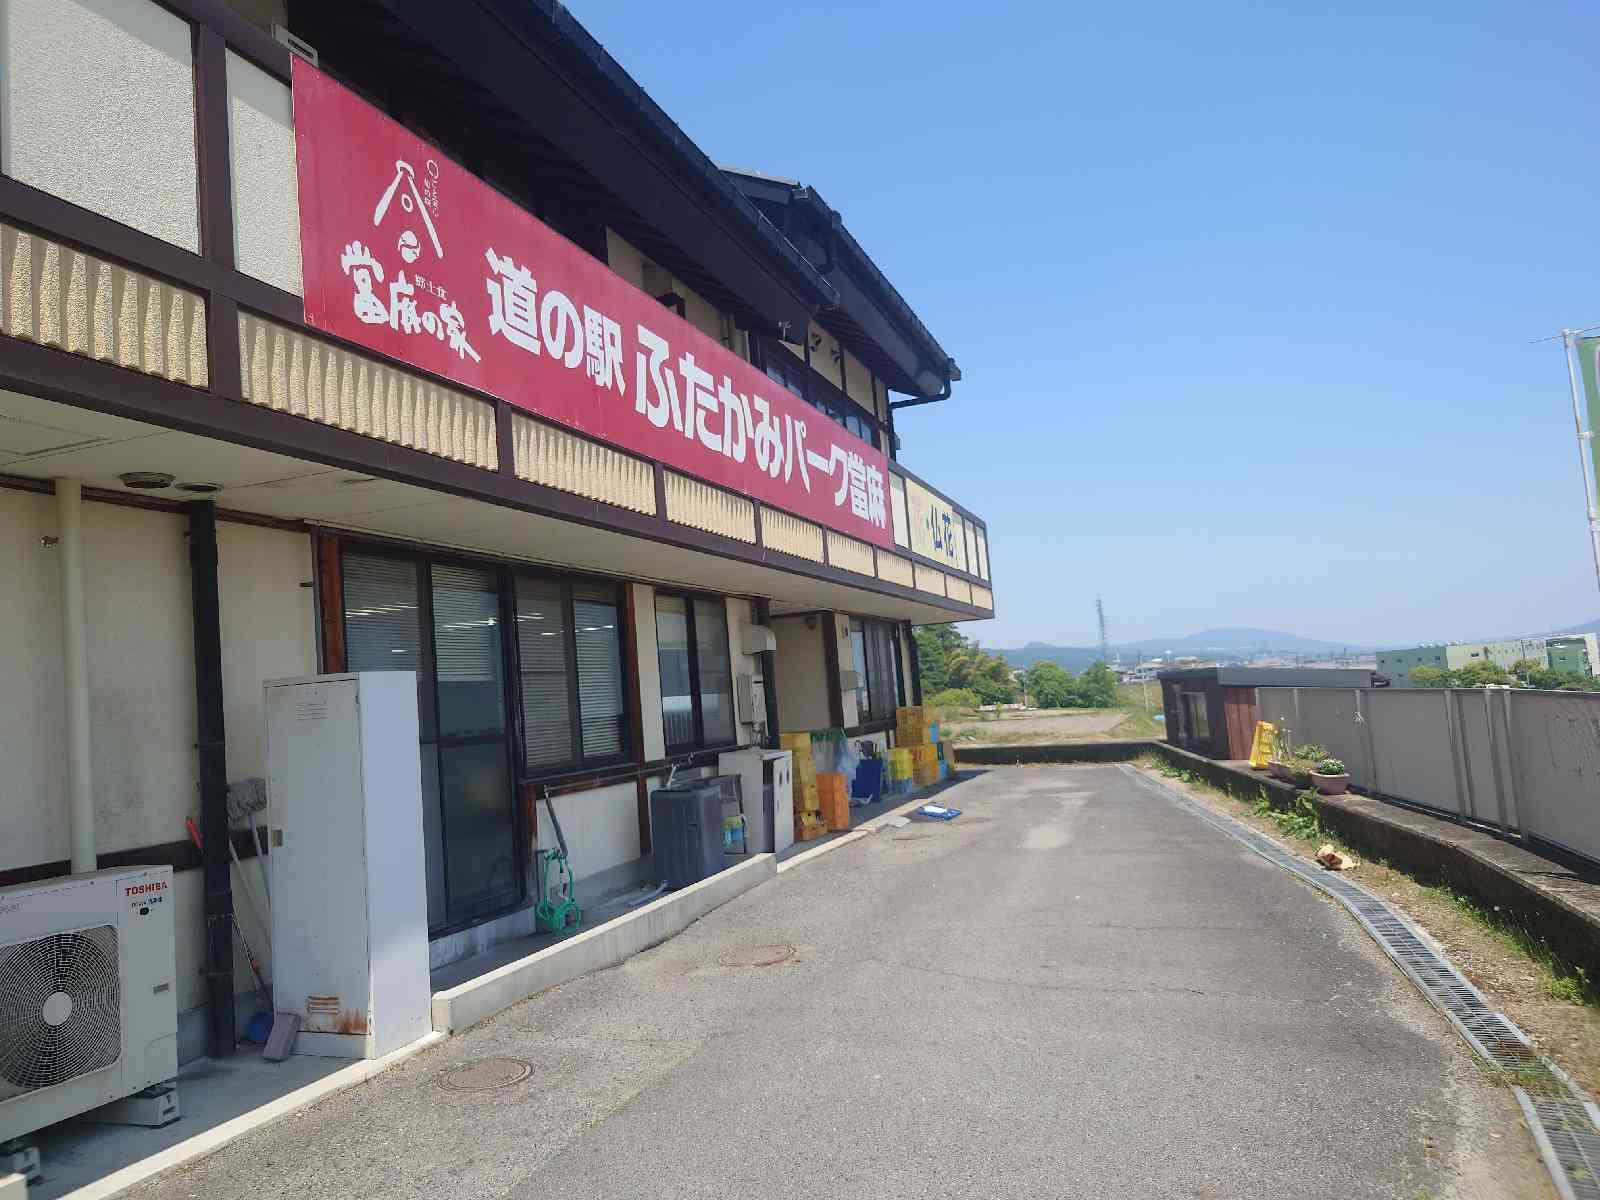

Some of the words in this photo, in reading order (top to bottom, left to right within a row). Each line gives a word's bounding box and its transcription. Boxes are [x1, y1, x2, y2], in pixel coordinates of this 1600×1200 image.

[485, 247, 626, 396] 道の駅
[635, 324, 886, 529] ふたかみパーク當麻
[125, 881, 168, 897] TOSHIBA
